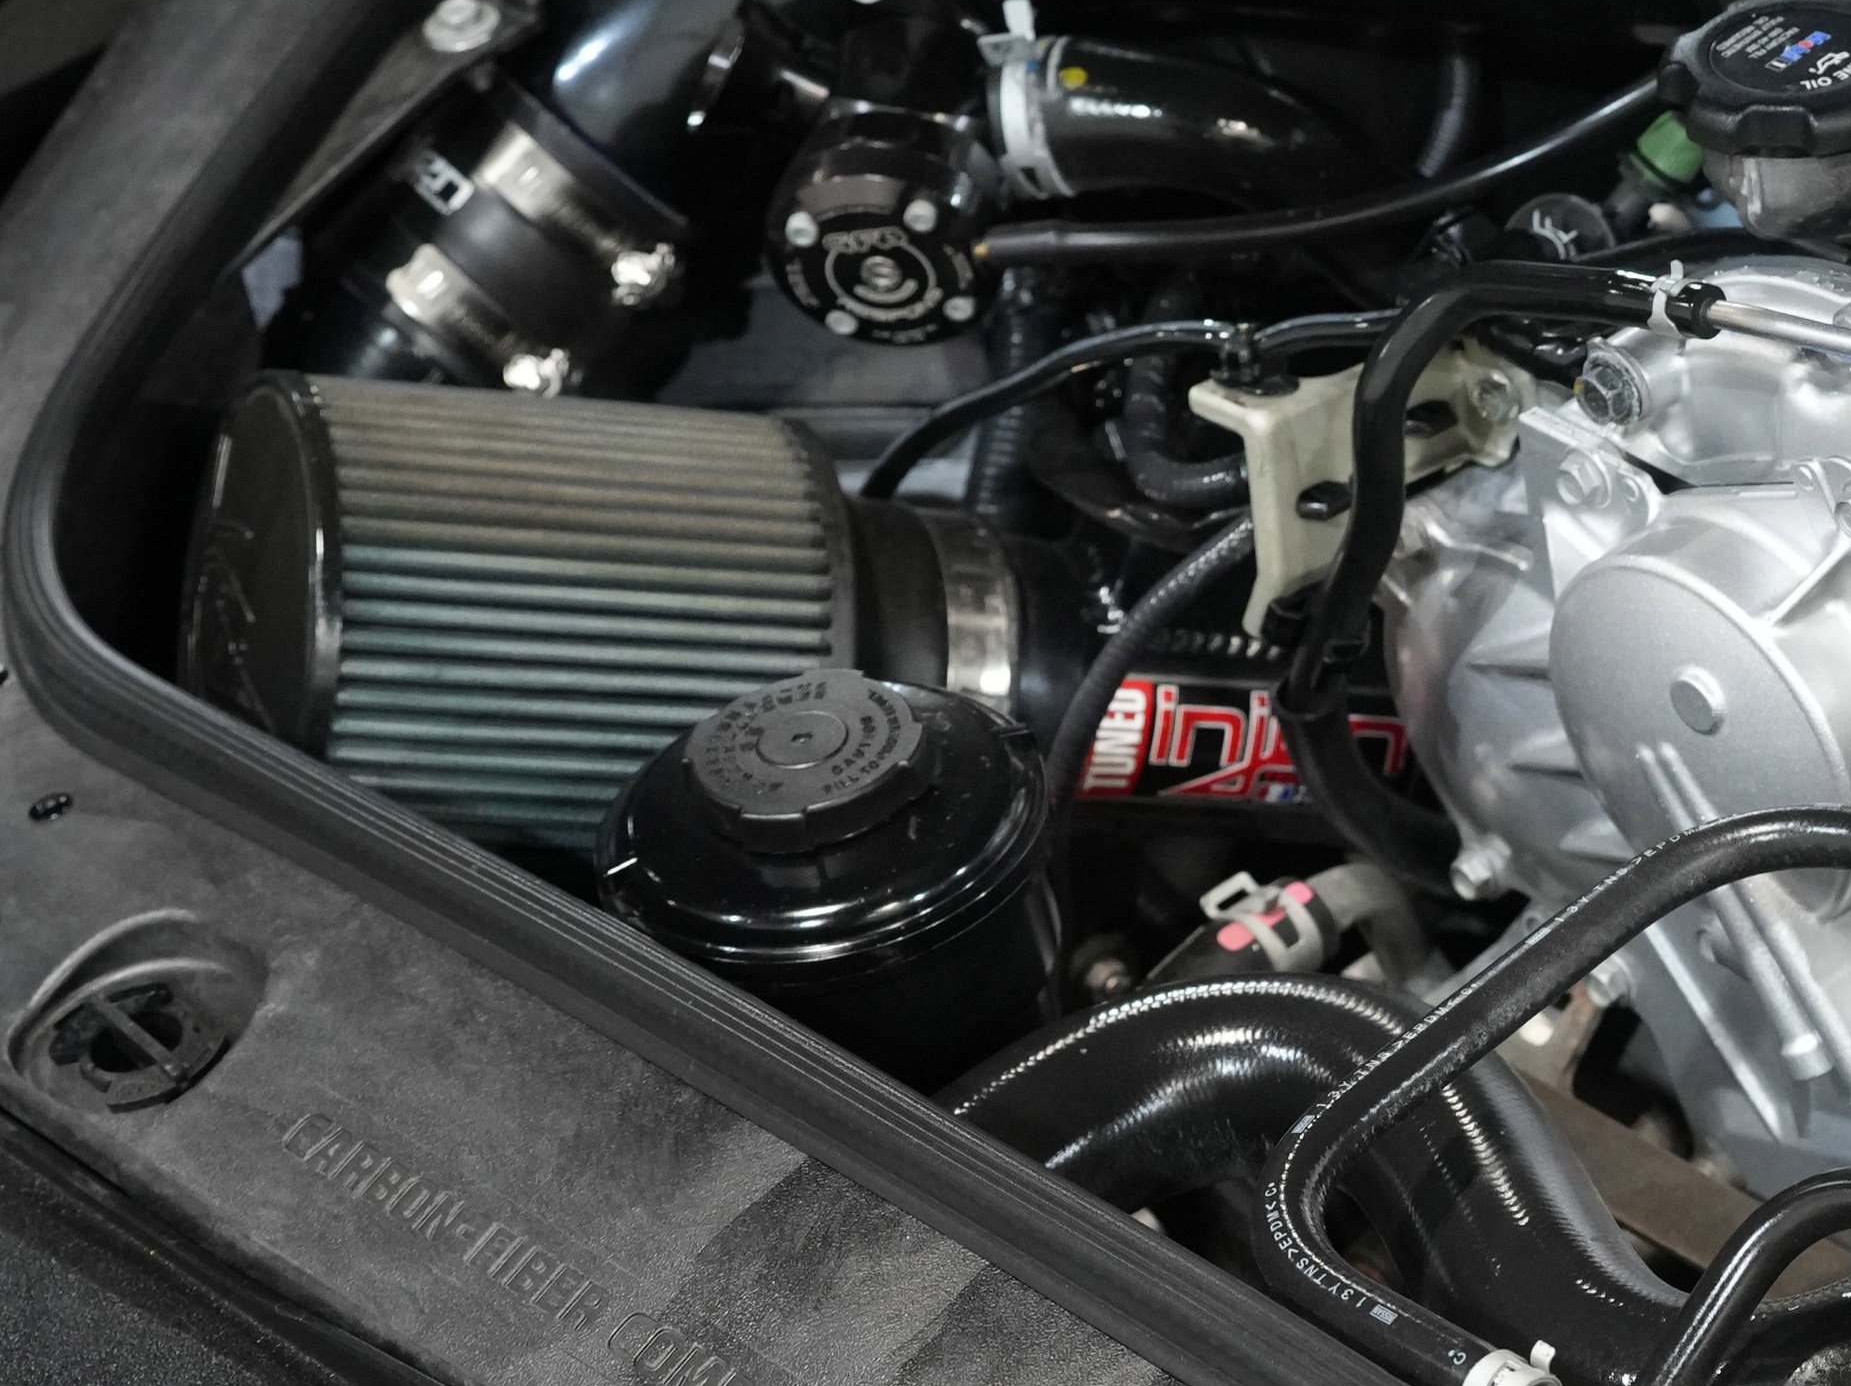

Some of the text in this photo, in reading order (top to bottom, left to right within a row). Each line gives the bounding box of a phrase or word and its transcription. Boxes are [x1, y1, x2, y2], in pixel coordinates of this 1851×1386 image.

[1799, 76, 1833, 90] OIL
[1083, 688, 1148, 790] TUNED
[281, 1110, 610, 1332] CARBON-FIBER
